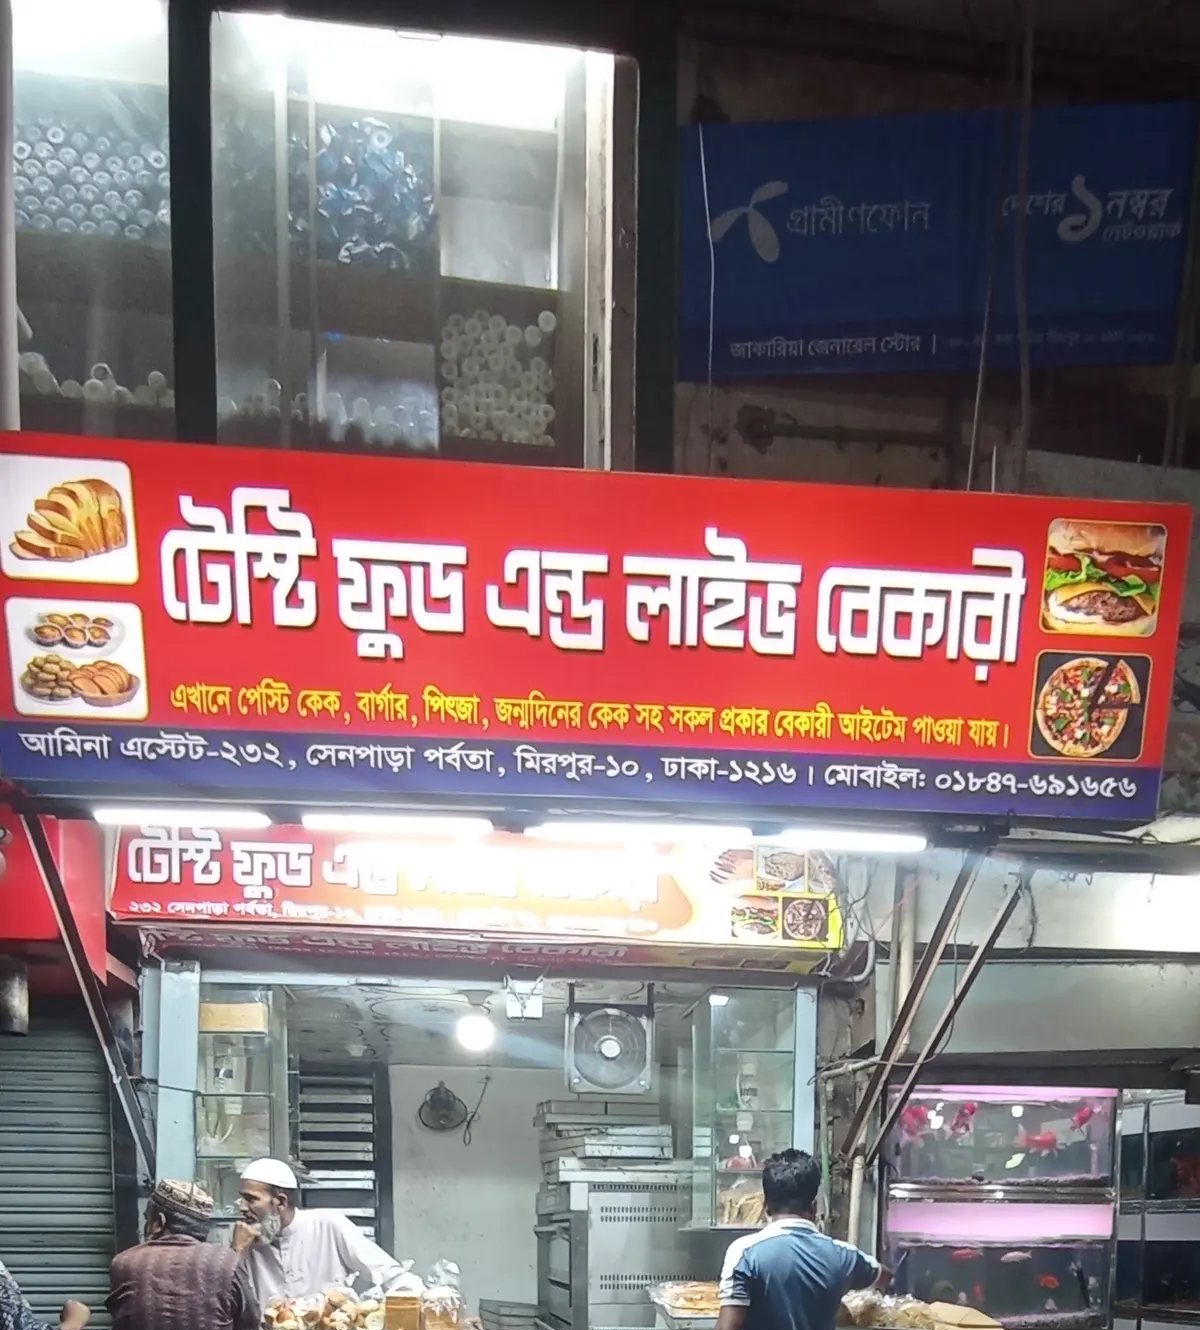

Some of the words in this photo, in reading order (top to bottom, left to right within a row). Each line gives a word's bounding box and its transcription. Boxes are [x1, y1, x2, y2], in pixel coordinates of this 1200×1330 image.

[786, 195, 931, 236] গ্রামীণফোন
[729, 335, 804, 360] জাকারিয়া
[880, 332, 921, 353] স্টোর
[159, 486, 318, 628] টেস্টি
[332, 538, 468, 660] ফুড
[485, 548, 609, 652] এন্ড
[622, 526, 803, 656] লাইভ
[815, 547, 1026, 682] বেকারী
[170, 681, 232, 716] এখানে
[237, 678, 291, 716] পেস্টি
[493, 690, 584, 730] জন্মদিনের
[587, 702, 631, 731] কেক
[633, 703, 665, 734] সহ
[667, 705, 716, 735] সকল
[718, 705, 771, 737] প্রকার
[773, 701, 835, 740] বেকারী
[837, 704, 908, 743] আইটেম
[911, 713, 965, 746] পাওয়া
[18, 726, 113, 760] আমিনা
[305, 743, 416, 774] সেনপাড়া
[934, 769, 1139, 798] ০১৮৪৭-৬৯১৬৫৬
[127, 824, 222, 885] টেস্টি
[230, 840, 315, 900] ফুড
[127, 900, 162, 914] ২৩২
